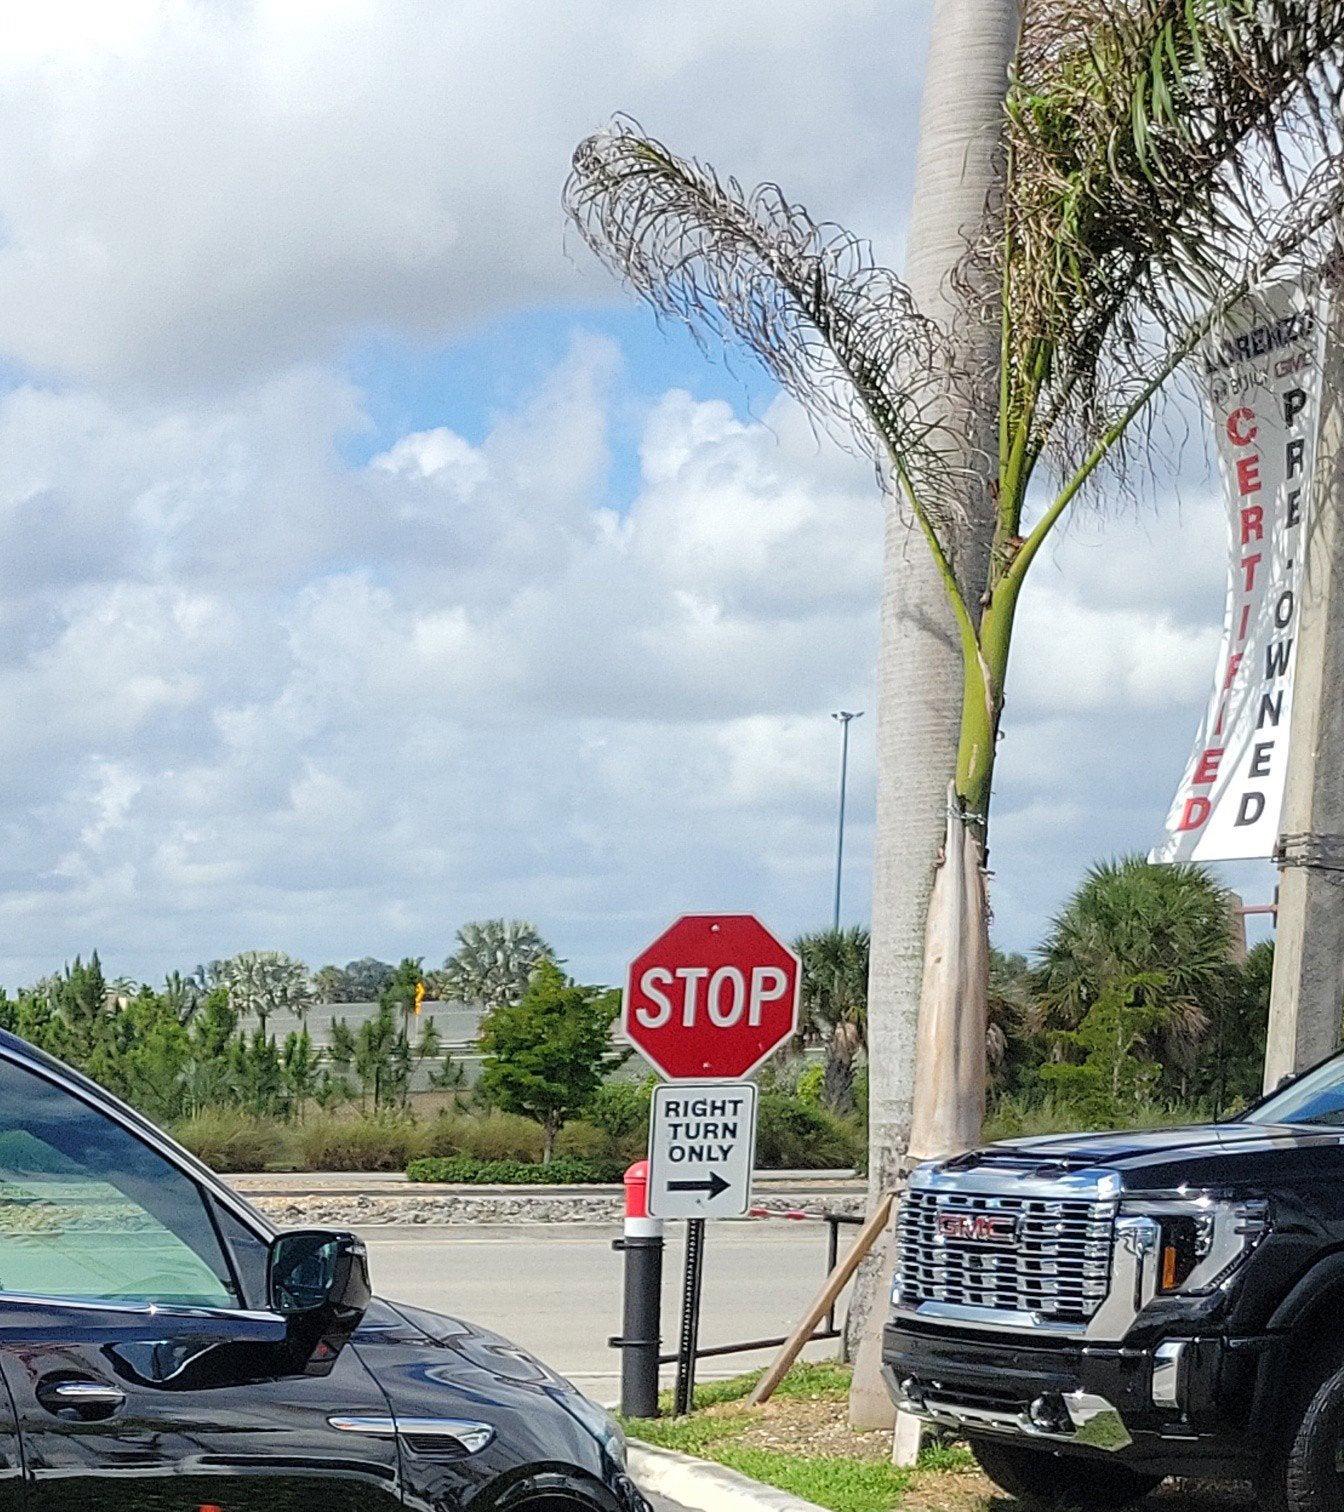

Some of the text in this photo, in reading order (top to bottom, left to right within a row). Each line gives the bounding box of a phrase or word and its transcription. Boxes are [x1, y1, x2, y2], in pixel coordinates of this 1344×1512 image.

[1178, 407, 1263, 831] CERTIFIED
[635, 966, 788, 1029] STOP
[665, 1099, 743, 1118] RIGHT
[668, 1123, 738, 1140] TURN
[668, 1145, 734, 1163] ONLY
[938, 1213, 1014, 1242] GMC
